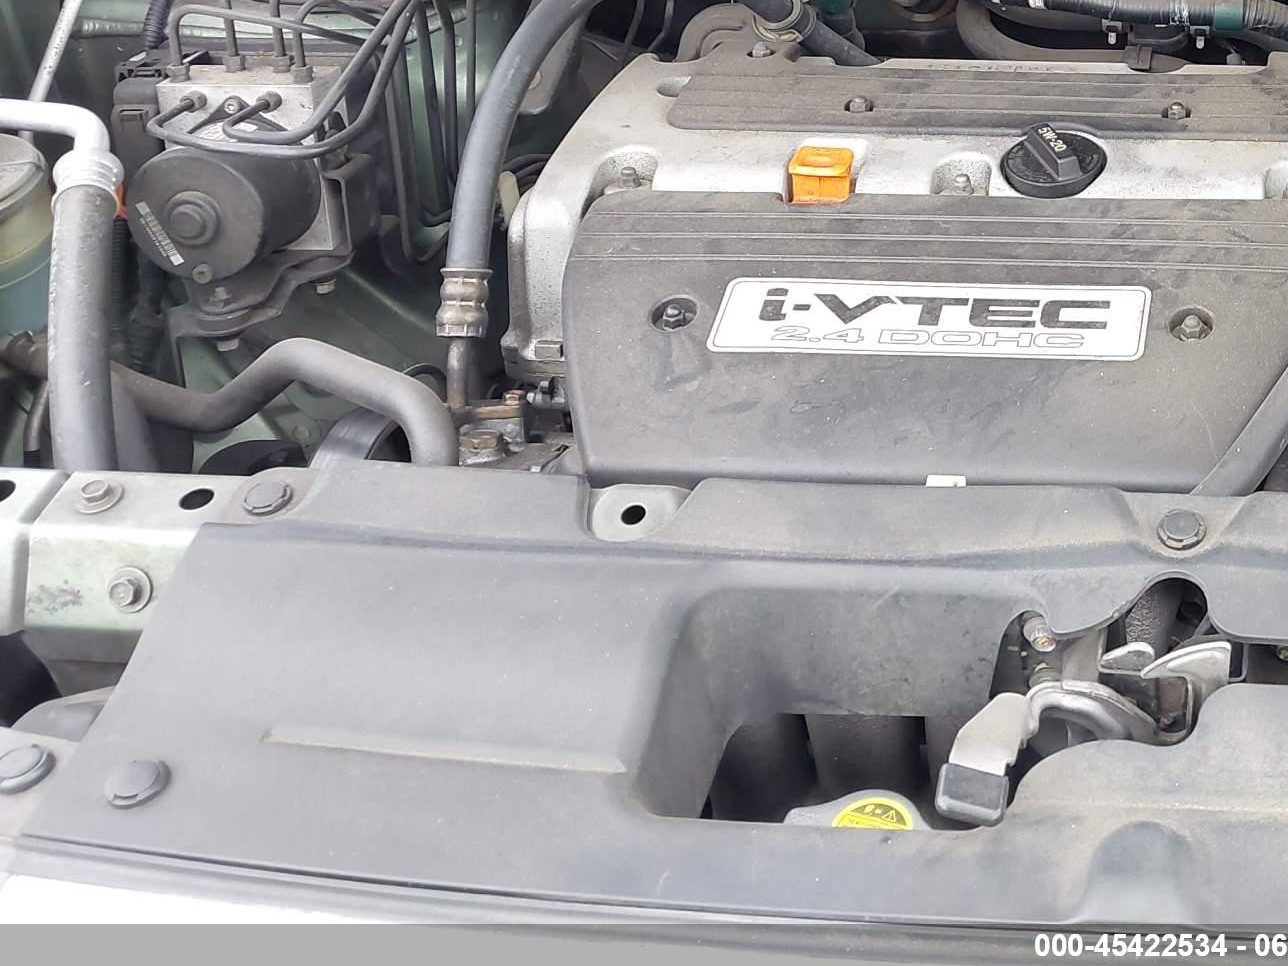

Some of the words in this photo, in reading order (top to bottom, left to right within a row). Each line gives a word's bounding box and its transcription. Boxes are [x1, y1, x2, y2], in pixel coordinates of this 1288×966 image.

[1038, 126, 1068, 153] 5W-20
[758, 287, 1111, 330] i-VTEC
[770, 325, 864, 343] 2.4
[878, 328, 1085, 349] DOHC
